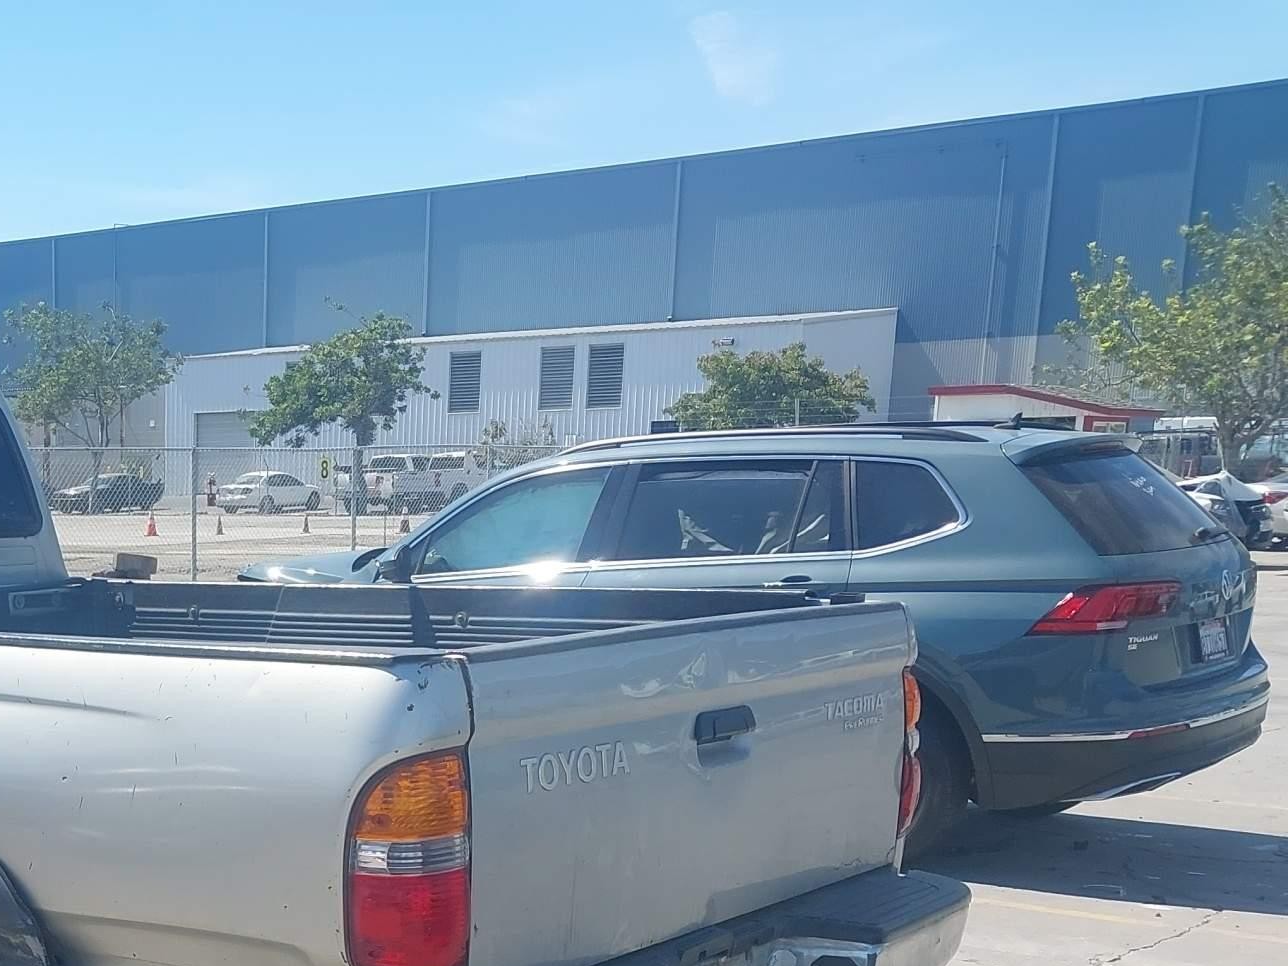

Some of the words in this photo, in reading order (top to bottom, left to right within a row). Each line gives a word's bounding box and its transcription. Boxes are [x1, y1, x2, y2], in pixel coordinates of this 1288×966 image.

[321, 460, 328, 478] 8
[824, 693, 883, 721] TACOMA
[520, 740, 630, 793] TOYOTA
